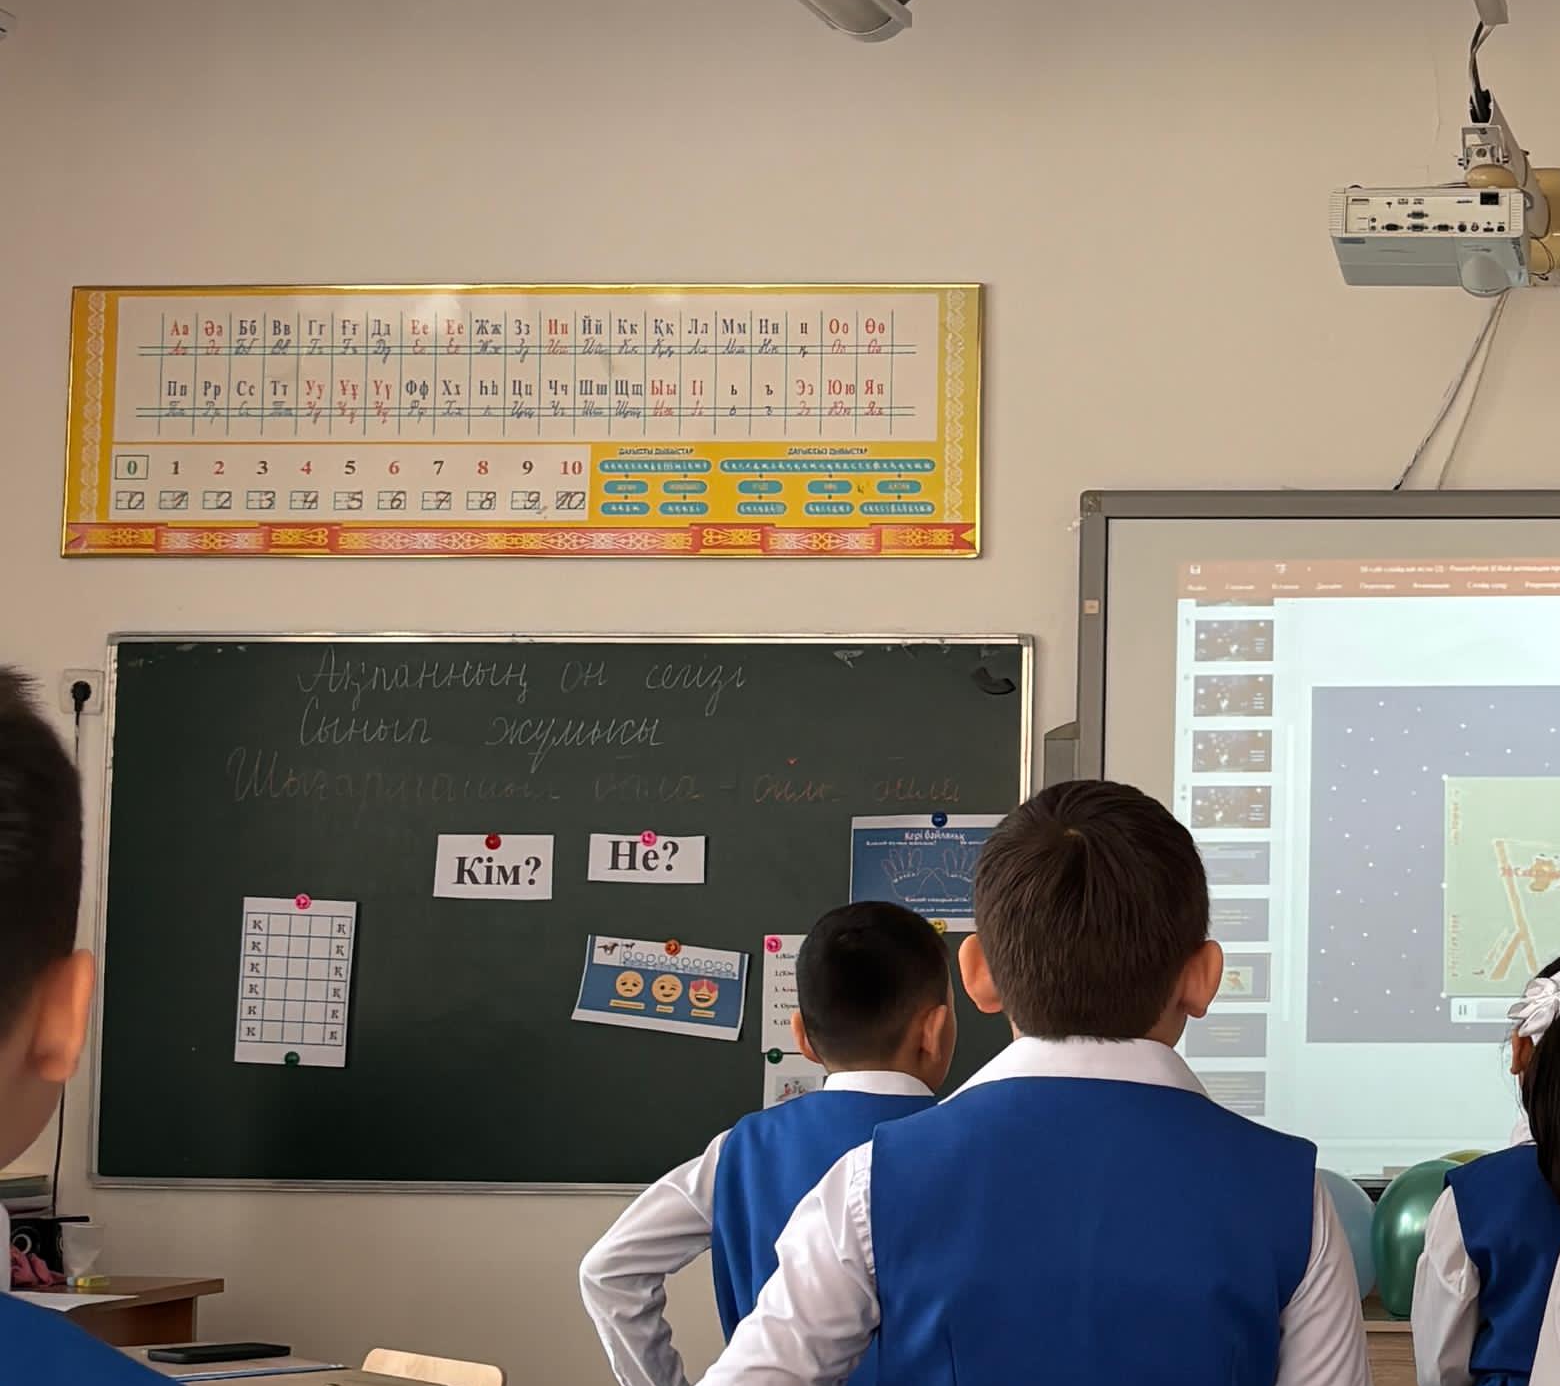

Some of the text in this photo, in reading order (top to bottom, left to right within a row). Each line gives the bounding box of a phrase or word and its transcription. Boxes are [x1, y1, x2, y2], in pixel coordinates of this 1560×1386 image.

[170, 319, 190, 336] Аа
[238, 319, 256, 336] Бб
[272, 319, 292, 336] Вв
[308, 319, 326, 336] Гг
[370, 319, 392, 338] Дд
[410, 319, 429, 336] Ее
[476, 319, 502, 336] Жж
[514, 319, 532, 336] Зз
[548, 319, 570, 336] Ии
[582, 315, 603, 335] Йй
[618, 319, 638, 336] Кк
[653, 318, 674, 338] Ққ
[687, 319, 708, 336] Лл
[722, 319, 746, 336] Мм
[759, 319, 780, 336] Нн
[828, 319, 850, 336] Оо
[168, 380, 188, 397] Пп
[203, 380, 222, 400] Рр
[236, 380, 256, 397] Сс
[270, 380, 289, 397] Тт
[304, 380, 326, 399] Уу
[405, 380, 429, 400] Фф
[440, 380, 462, 397] Хх
[512, 381, 533, 399] Цц
[548, 380, 569, 397] Чч
[578, 380, 608, 397] Шш
[614, 380, 644, 399] Щщ
[650, 380, 677, 397] Ыы
[795, 380, 814, 397] Ээ
[827, 380, 856, 397] Юю
[864, 380, 884, 397] Яя
[127, 459, 583, 476] 0 1 2 3 4 5 6 7 8 9 10
[560, 660, 610, 693] он
[298, 697, 432, 749] Сынып
[454, 838, 680, 887] Кім? Не?
